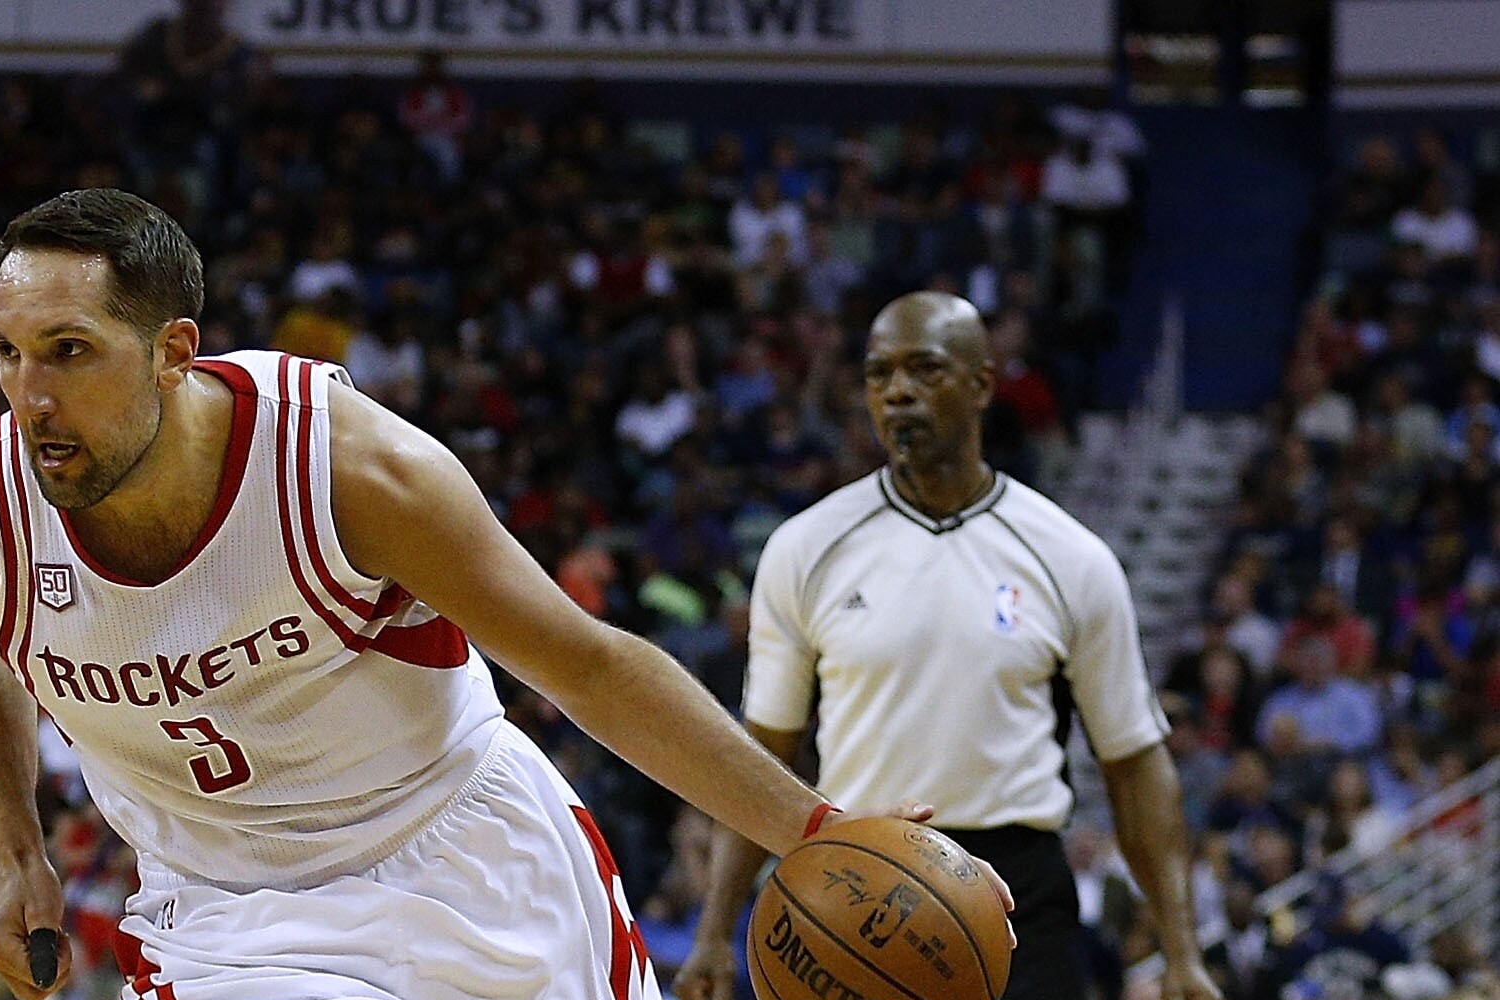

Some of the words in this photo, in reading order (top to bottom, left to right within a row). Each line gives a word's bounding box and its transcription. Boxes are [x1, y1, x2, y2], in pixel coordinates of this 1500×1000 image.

[41, 570, 67, 592] 50
[36, 615, 310, 707] ROCKETS
[159, 715, 253, 795] 3
